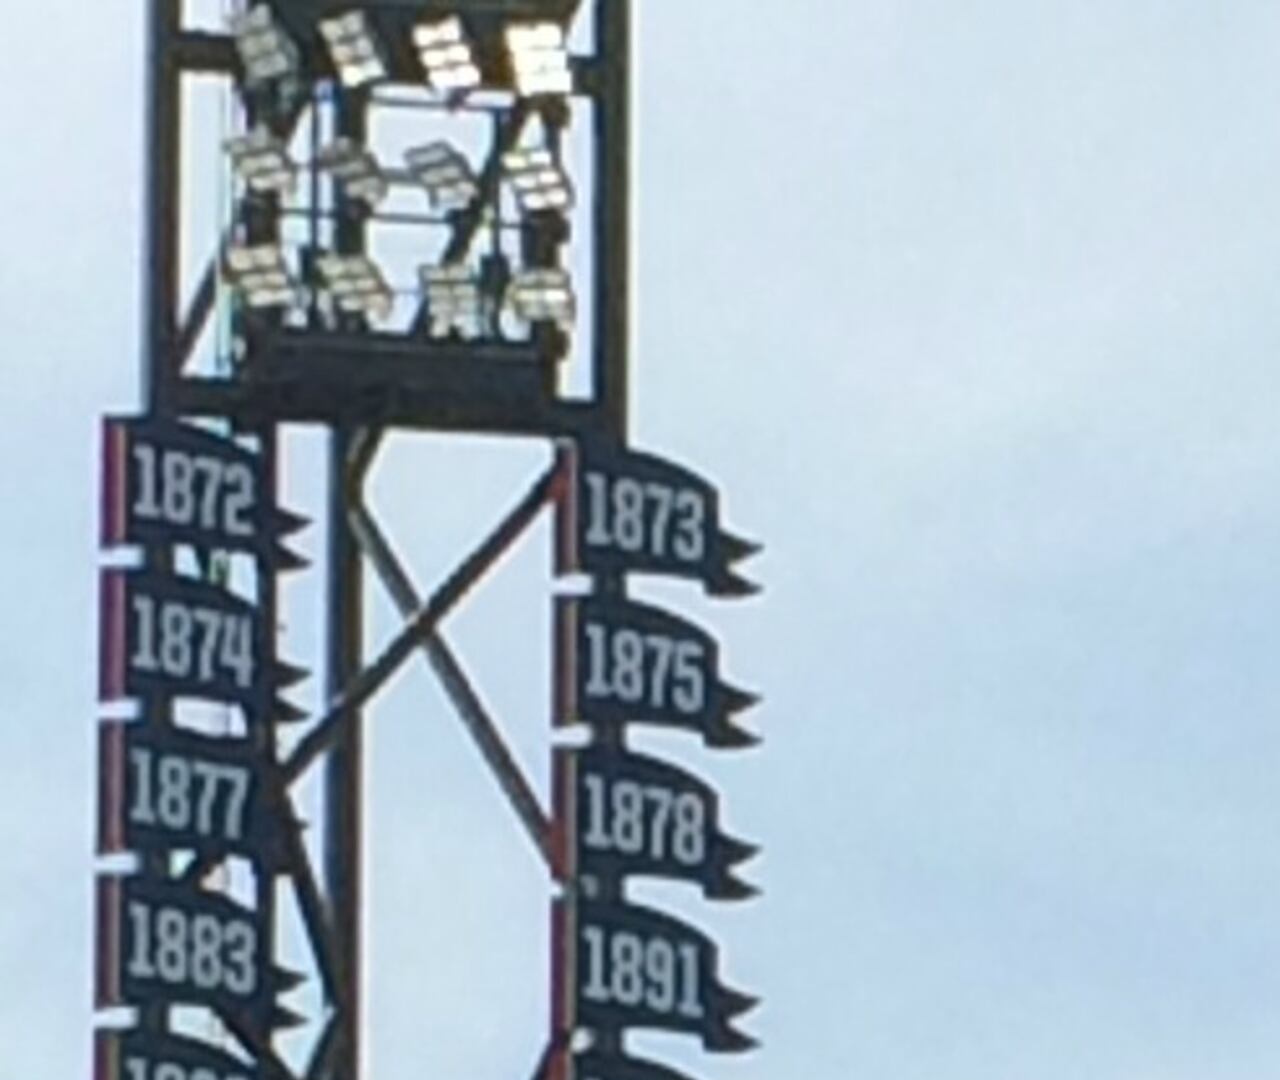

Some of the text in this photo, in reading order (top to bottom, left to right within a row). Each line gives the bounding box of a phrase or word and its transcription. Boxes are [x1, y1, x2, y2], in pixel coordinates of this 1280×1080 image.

[133, 446, 254, 537] 1872
[584, 473, 703, 560] 1873
[132, 597, 253, 687] 1874
[584, 624, 703, 712] 1875
[131, 749, 250, 840] 1877
[584, 776, 705, 864] 1878
[128, 902, 257, 994] 1883
[583, 926, 703, 1016] 1891
